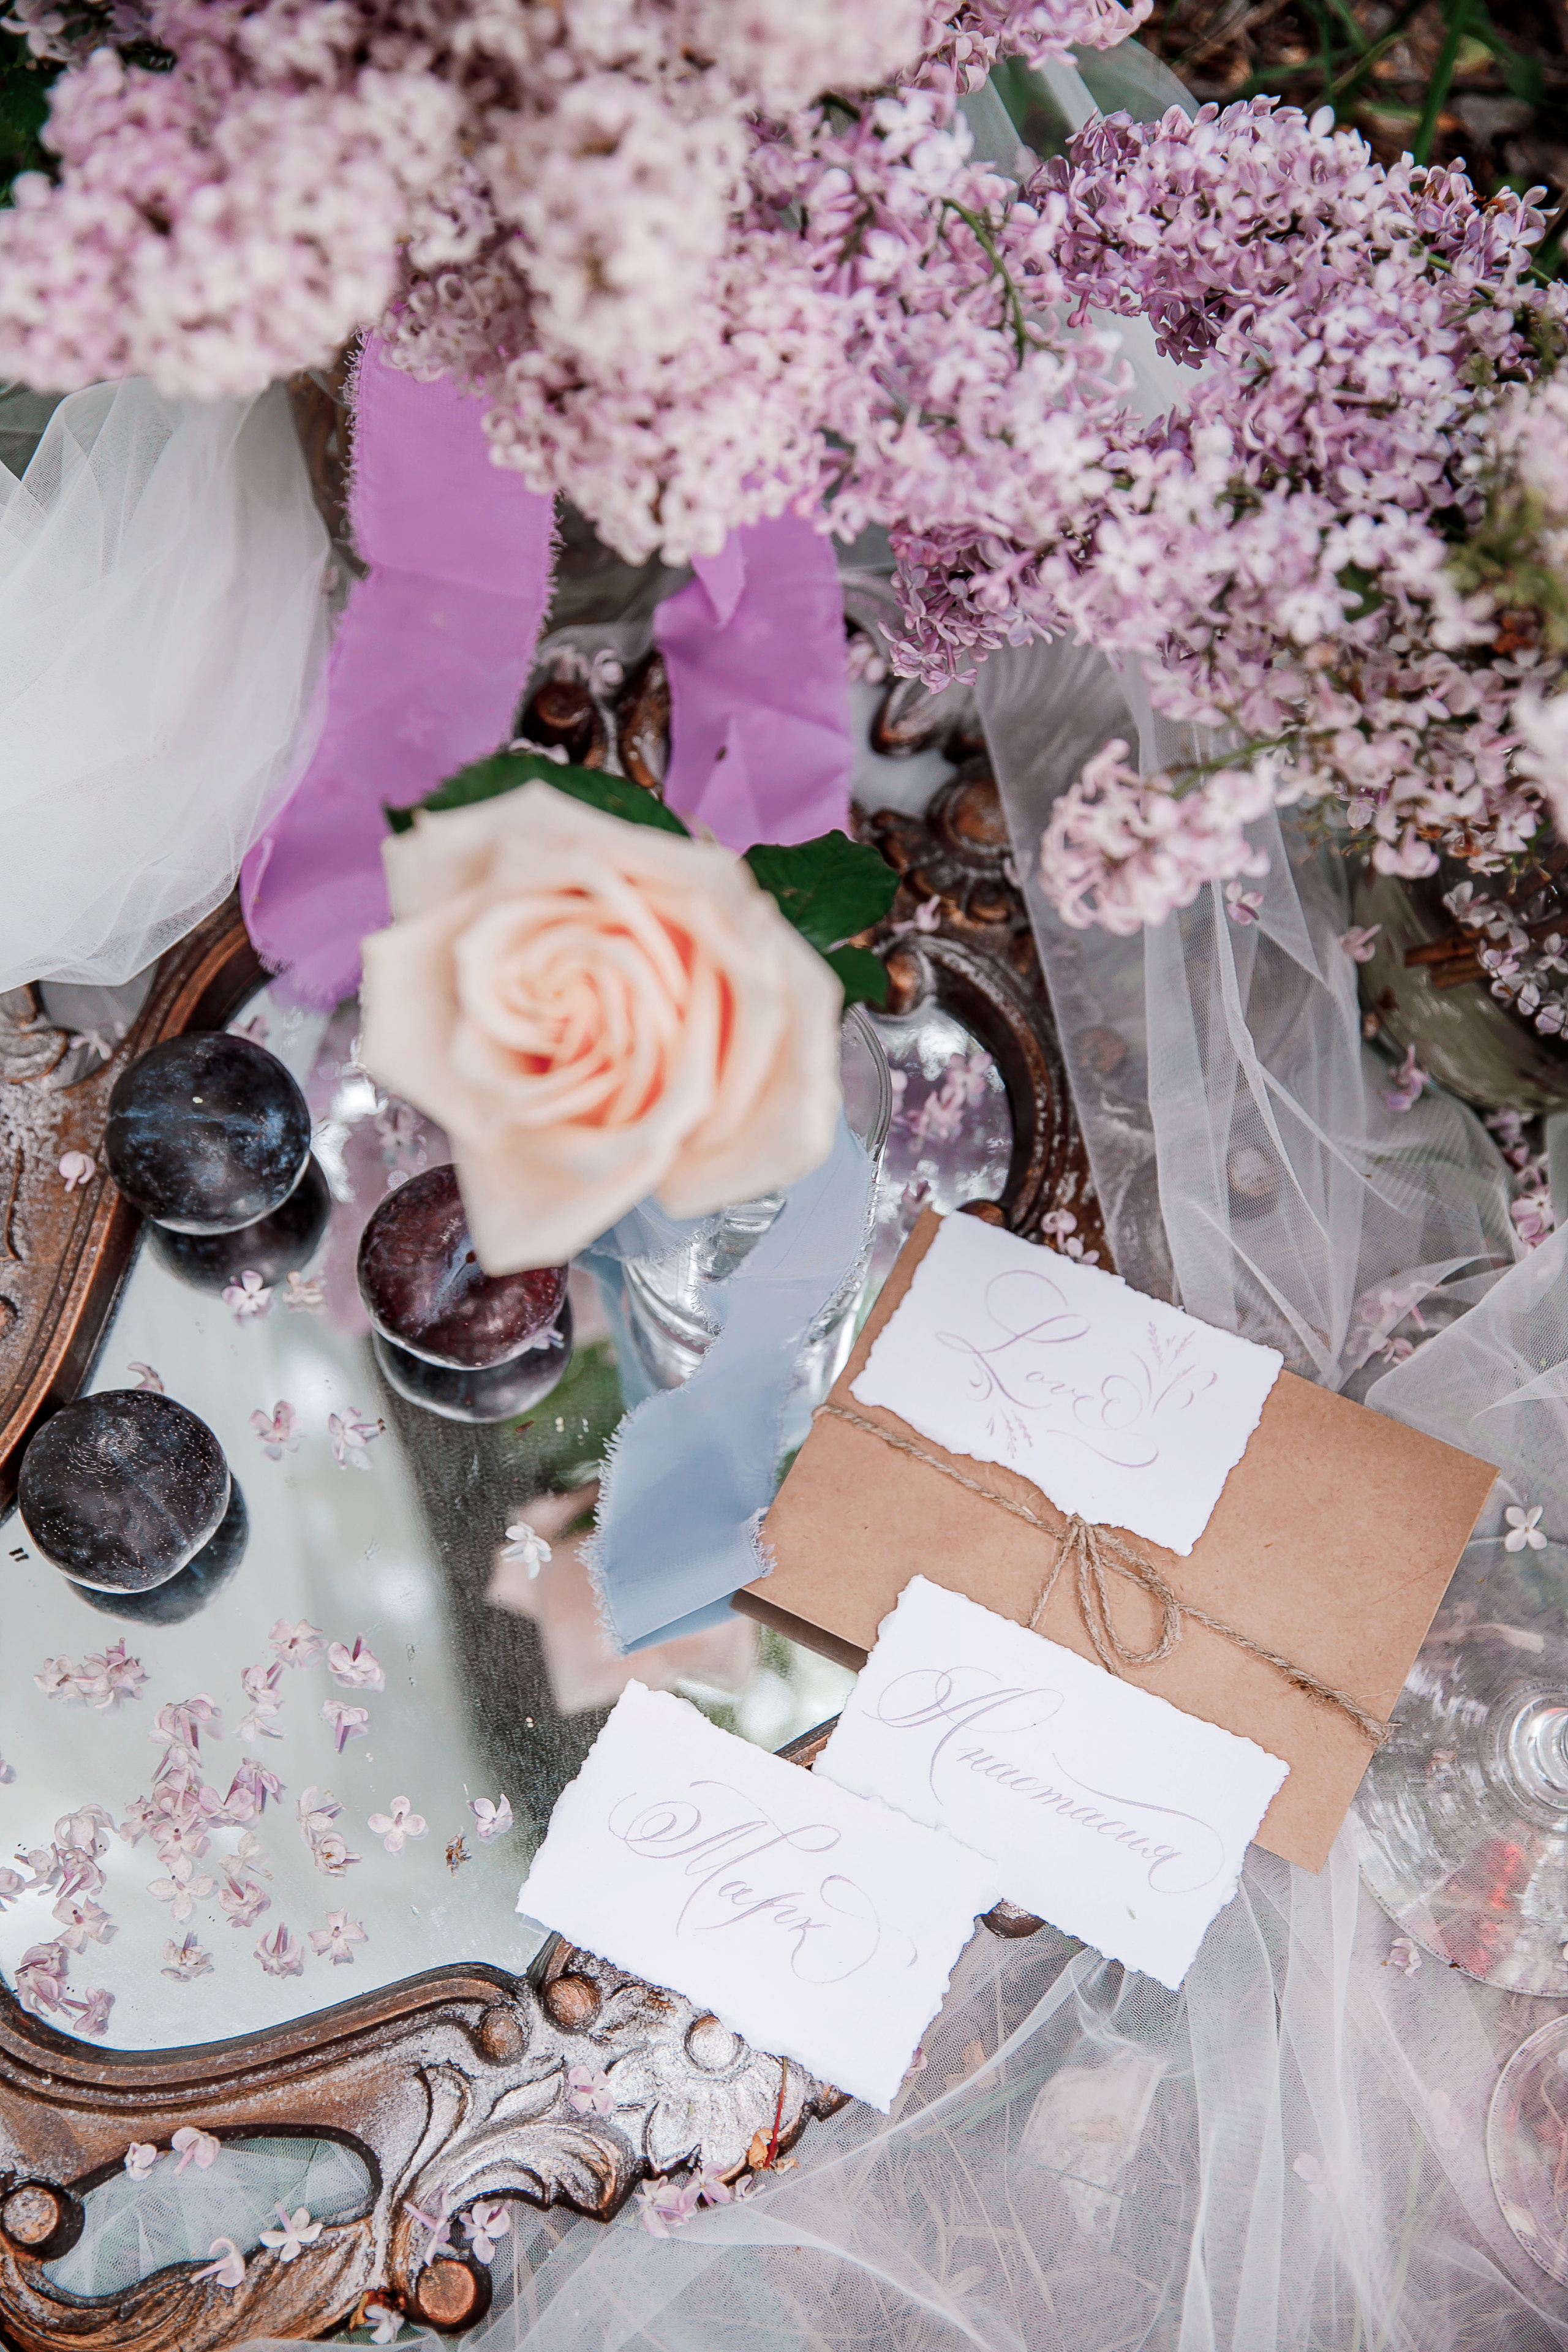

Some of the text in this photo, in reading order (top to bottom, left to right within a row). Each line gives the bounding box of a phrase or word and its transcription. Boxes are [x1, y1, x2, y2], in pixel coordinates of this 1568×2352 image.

[935, 1270, 1159, 1468] Love
[862, 1667, 1224, 1893] Анастасия
[608, 1781, 918, 1983] Марк
